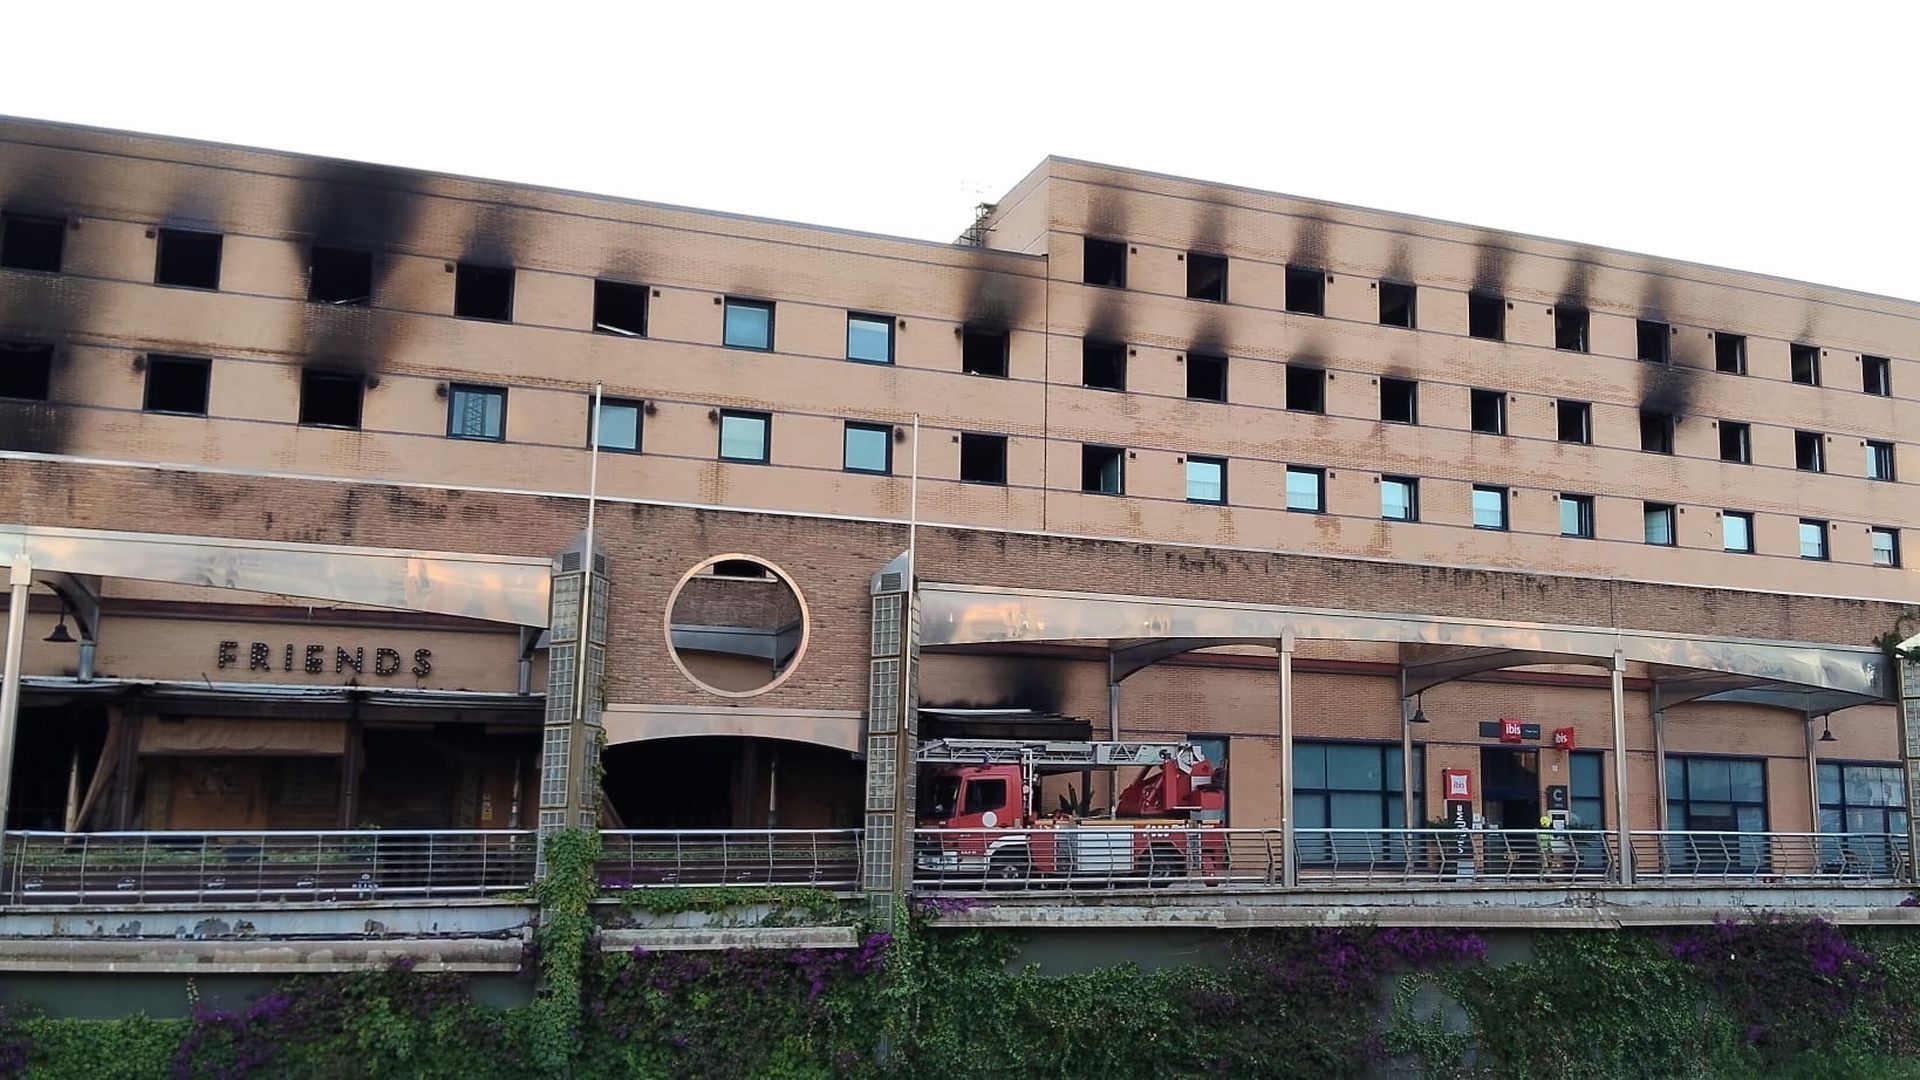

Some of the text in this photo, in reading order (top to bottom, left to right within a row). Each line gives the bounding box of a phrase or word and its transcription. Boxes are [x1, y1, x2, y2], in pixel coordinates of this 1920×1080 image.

[218, 640, 432, 676] FRIENDS
[1505, 723, 1521, 735] ibis
[1555, 732, 1568, 744] ibis
[1553, 789, 1563, 801] C
